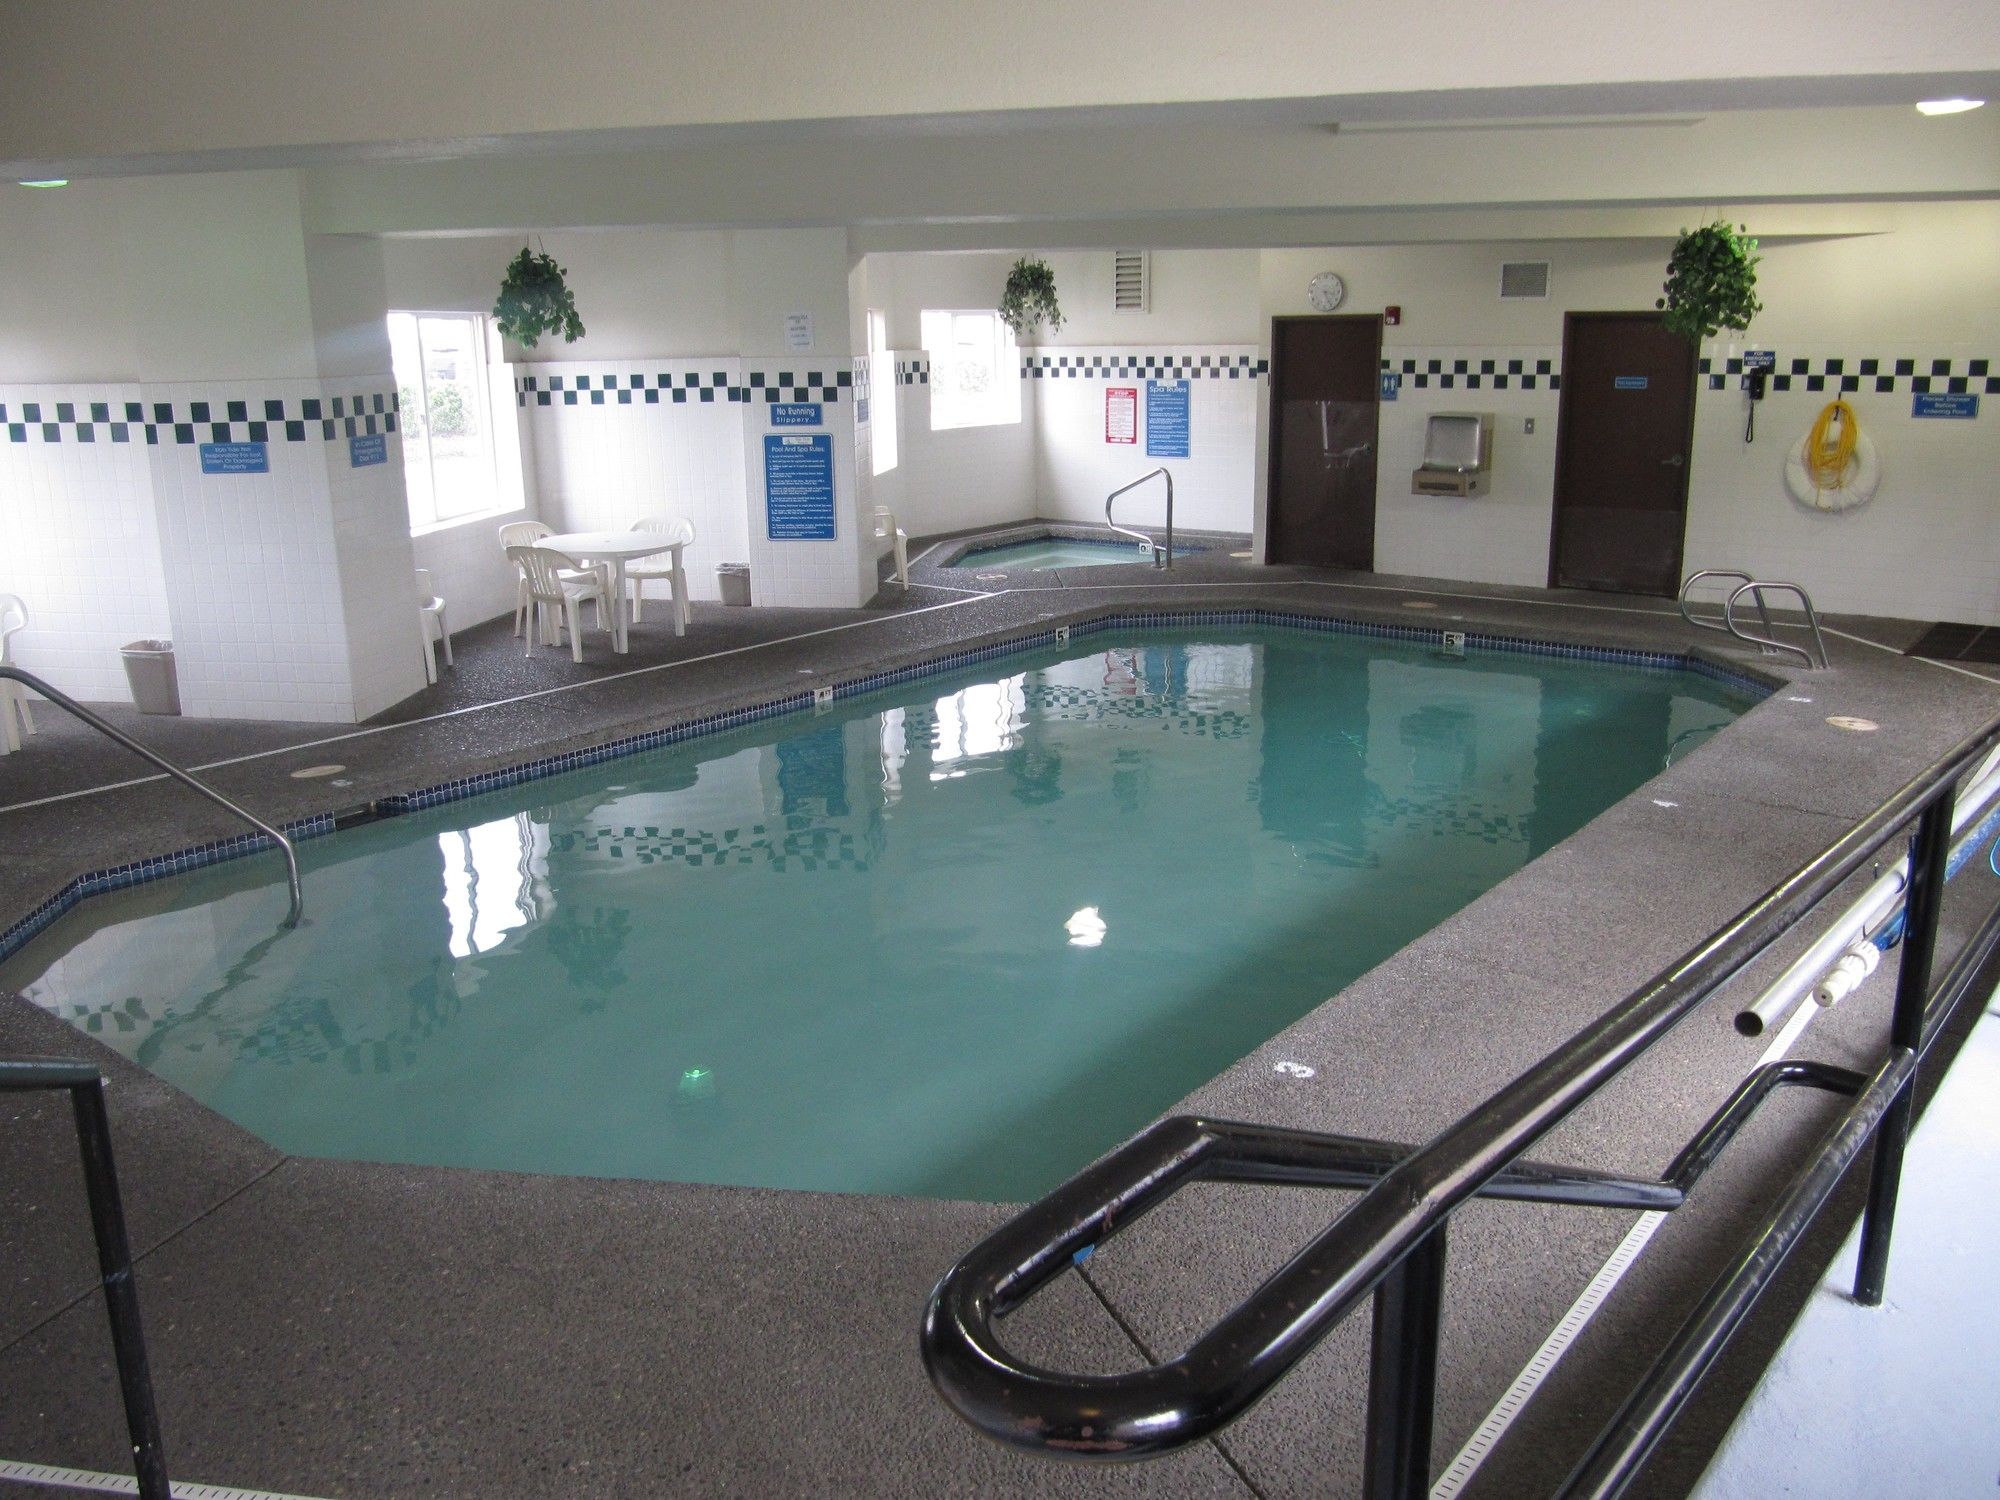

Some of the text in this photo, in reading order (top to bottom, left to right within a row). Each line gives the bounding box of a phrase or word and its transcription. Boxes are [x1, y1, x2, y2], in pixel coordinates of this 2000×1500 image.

[776, 407, 815, 417] No Running
[1057, 630, 1064, 640] 5
[1446, 634, 1455, 645] 5
